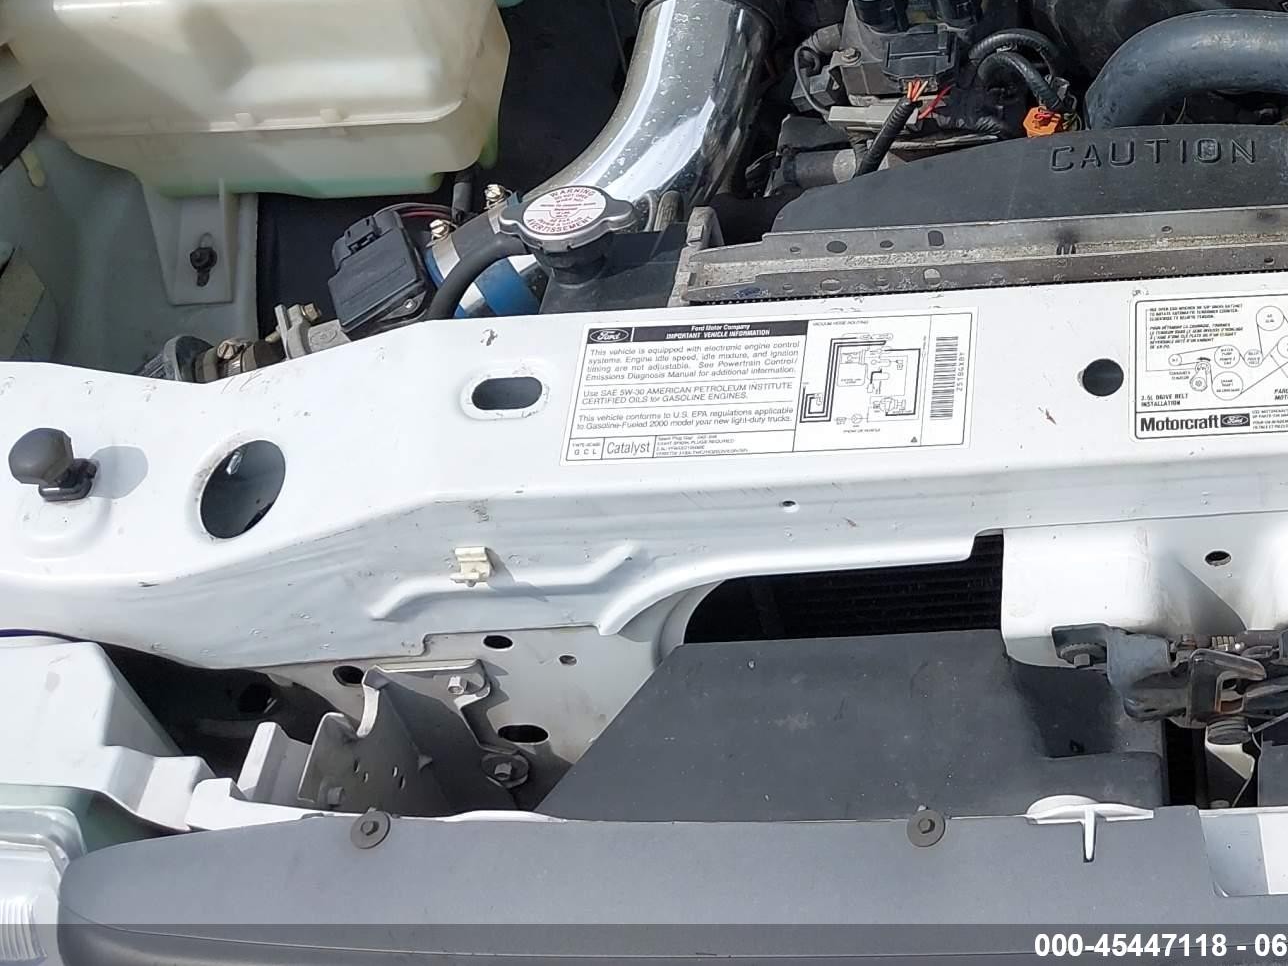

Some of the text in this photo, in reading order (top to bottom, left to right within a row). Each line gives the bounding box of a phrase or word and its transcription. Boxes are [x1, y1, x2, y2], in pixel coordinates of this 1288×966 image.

[1050, 138, 1257, 172] CAUTION
[550, 188, 596, 197] WARNING
[596, 330, 621, 340] Ford
[648, 346, 683, 355] equipped
[704, 343, 741, 351] electronic
[744, 342, 770, 351] engine
[625, 356, 652, 365] Engine
[672, 354, 698, 363] speed,
[770, 350, 799, 358] ignition
[587, 365, 611, 374] timing
[647, 362, 690, 371] adjustable.
[698, 361, 714, 369] See
[718, 359, 761, 368] Powertrain
[764, 357, 798, 366] Control/
[585, 366, 796, 381] Emissions Diagnosis Manual for additional information.
[619, 388, 645, 396] 5W-30
[647, 386, 692, 395] AMERICAN
[694, 384, 747, 393] PETROLEUM
[749, 382, 793, 390] INSTITUTE
[582, 397, 626, 405] CERTIFIED
[662, 393, 705, 402] GASOLINE
[708, 392, 748, 400] ENGINES.
[578, 414, 594, 422] This
[596, 413, 624, 421] vehicle
[625, 412, 661, 420] conforms
[709, 409, 752, 418] regulations
[754, 407, 794, 416] applicable
[1226, 415, 1245, 425] Ford
[586, 421, 648, 430] Gasoline-Fueled
[696, 419, 711, 427] year
[731, 416, 765, 425] light-duty
[1140, 415, 1219, 432] Motorcraft
[607, 440, 650, 456] Catalyst
